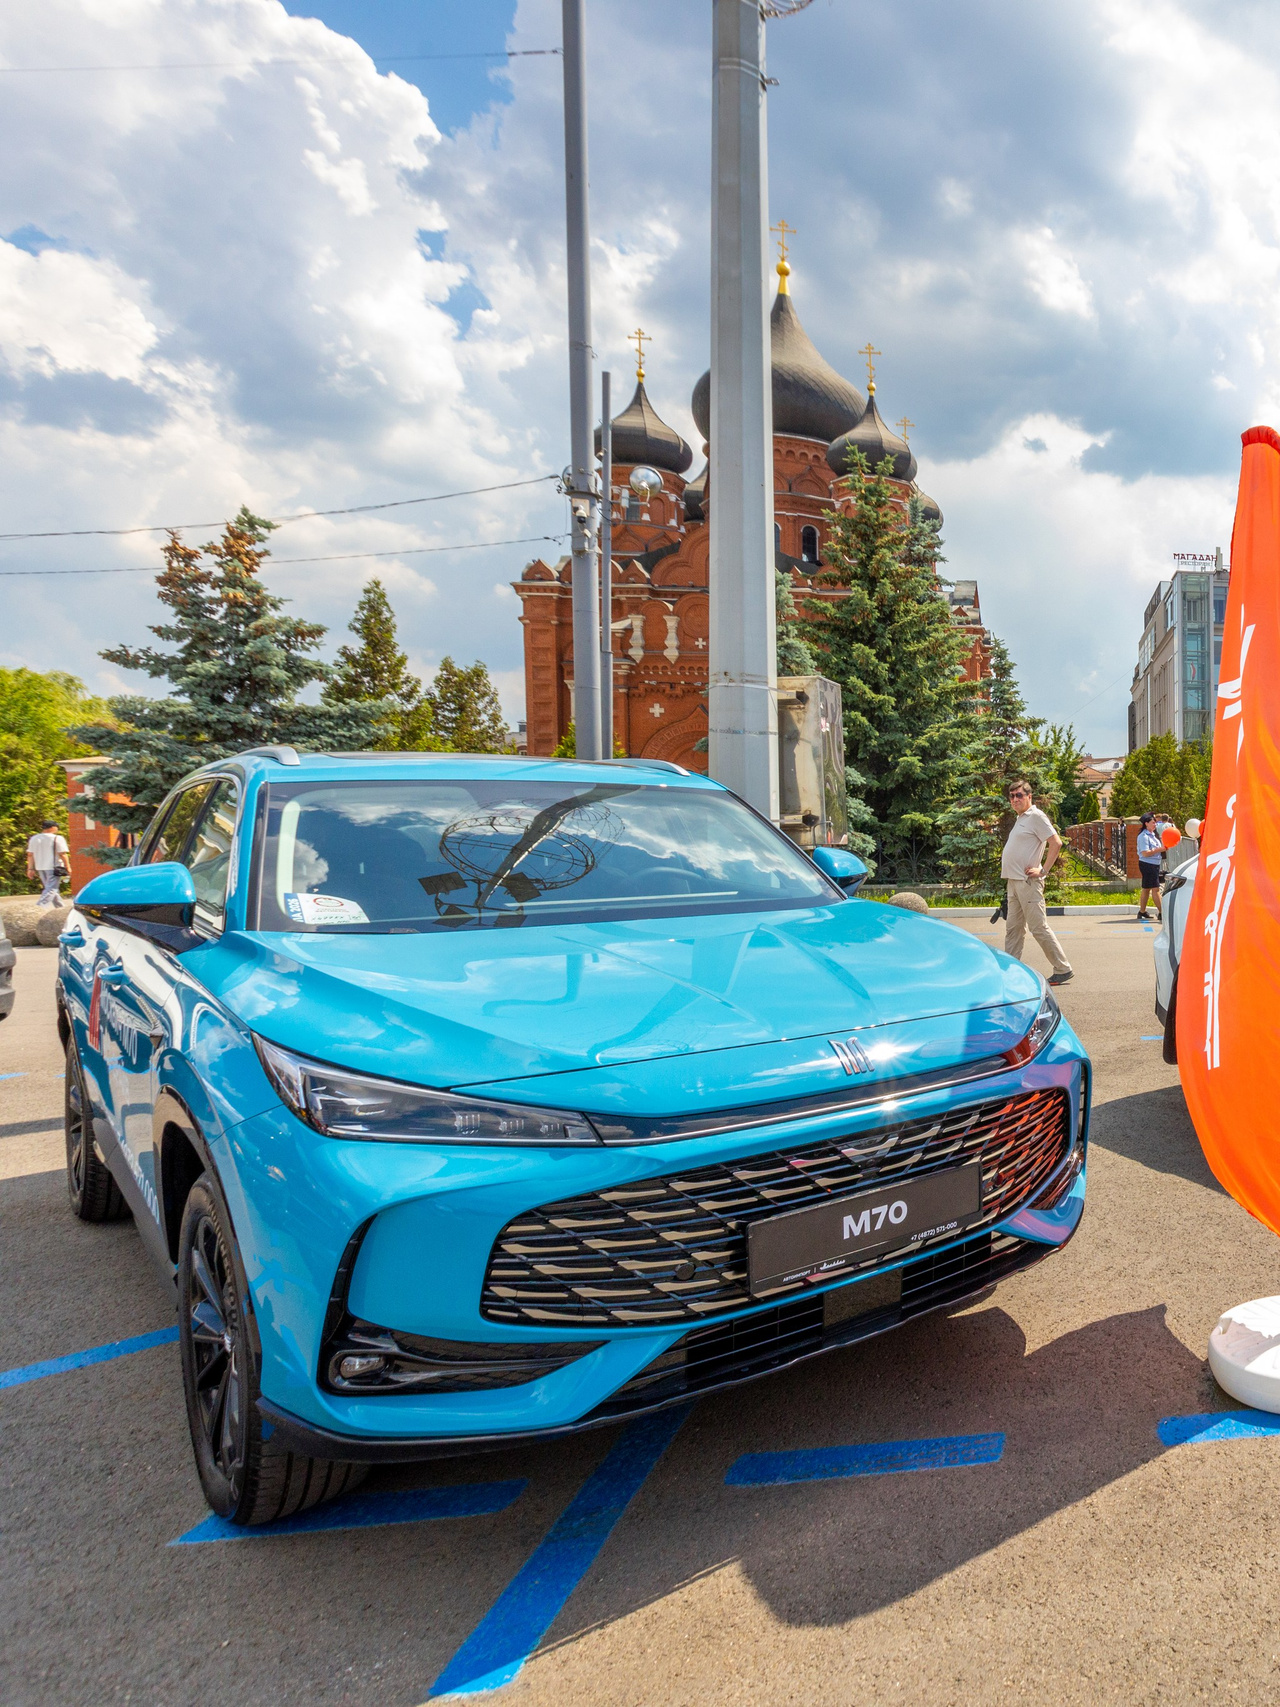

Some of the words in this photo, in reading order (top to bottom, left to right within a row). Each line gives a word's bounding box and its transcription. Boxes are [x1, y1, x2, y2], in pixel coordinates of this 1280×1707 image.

[1173, 553, 1218, 561] МАГАДАН
[843, 1200, 908, 1240] M70
[918, 1229, 936, 1240] (4872)
